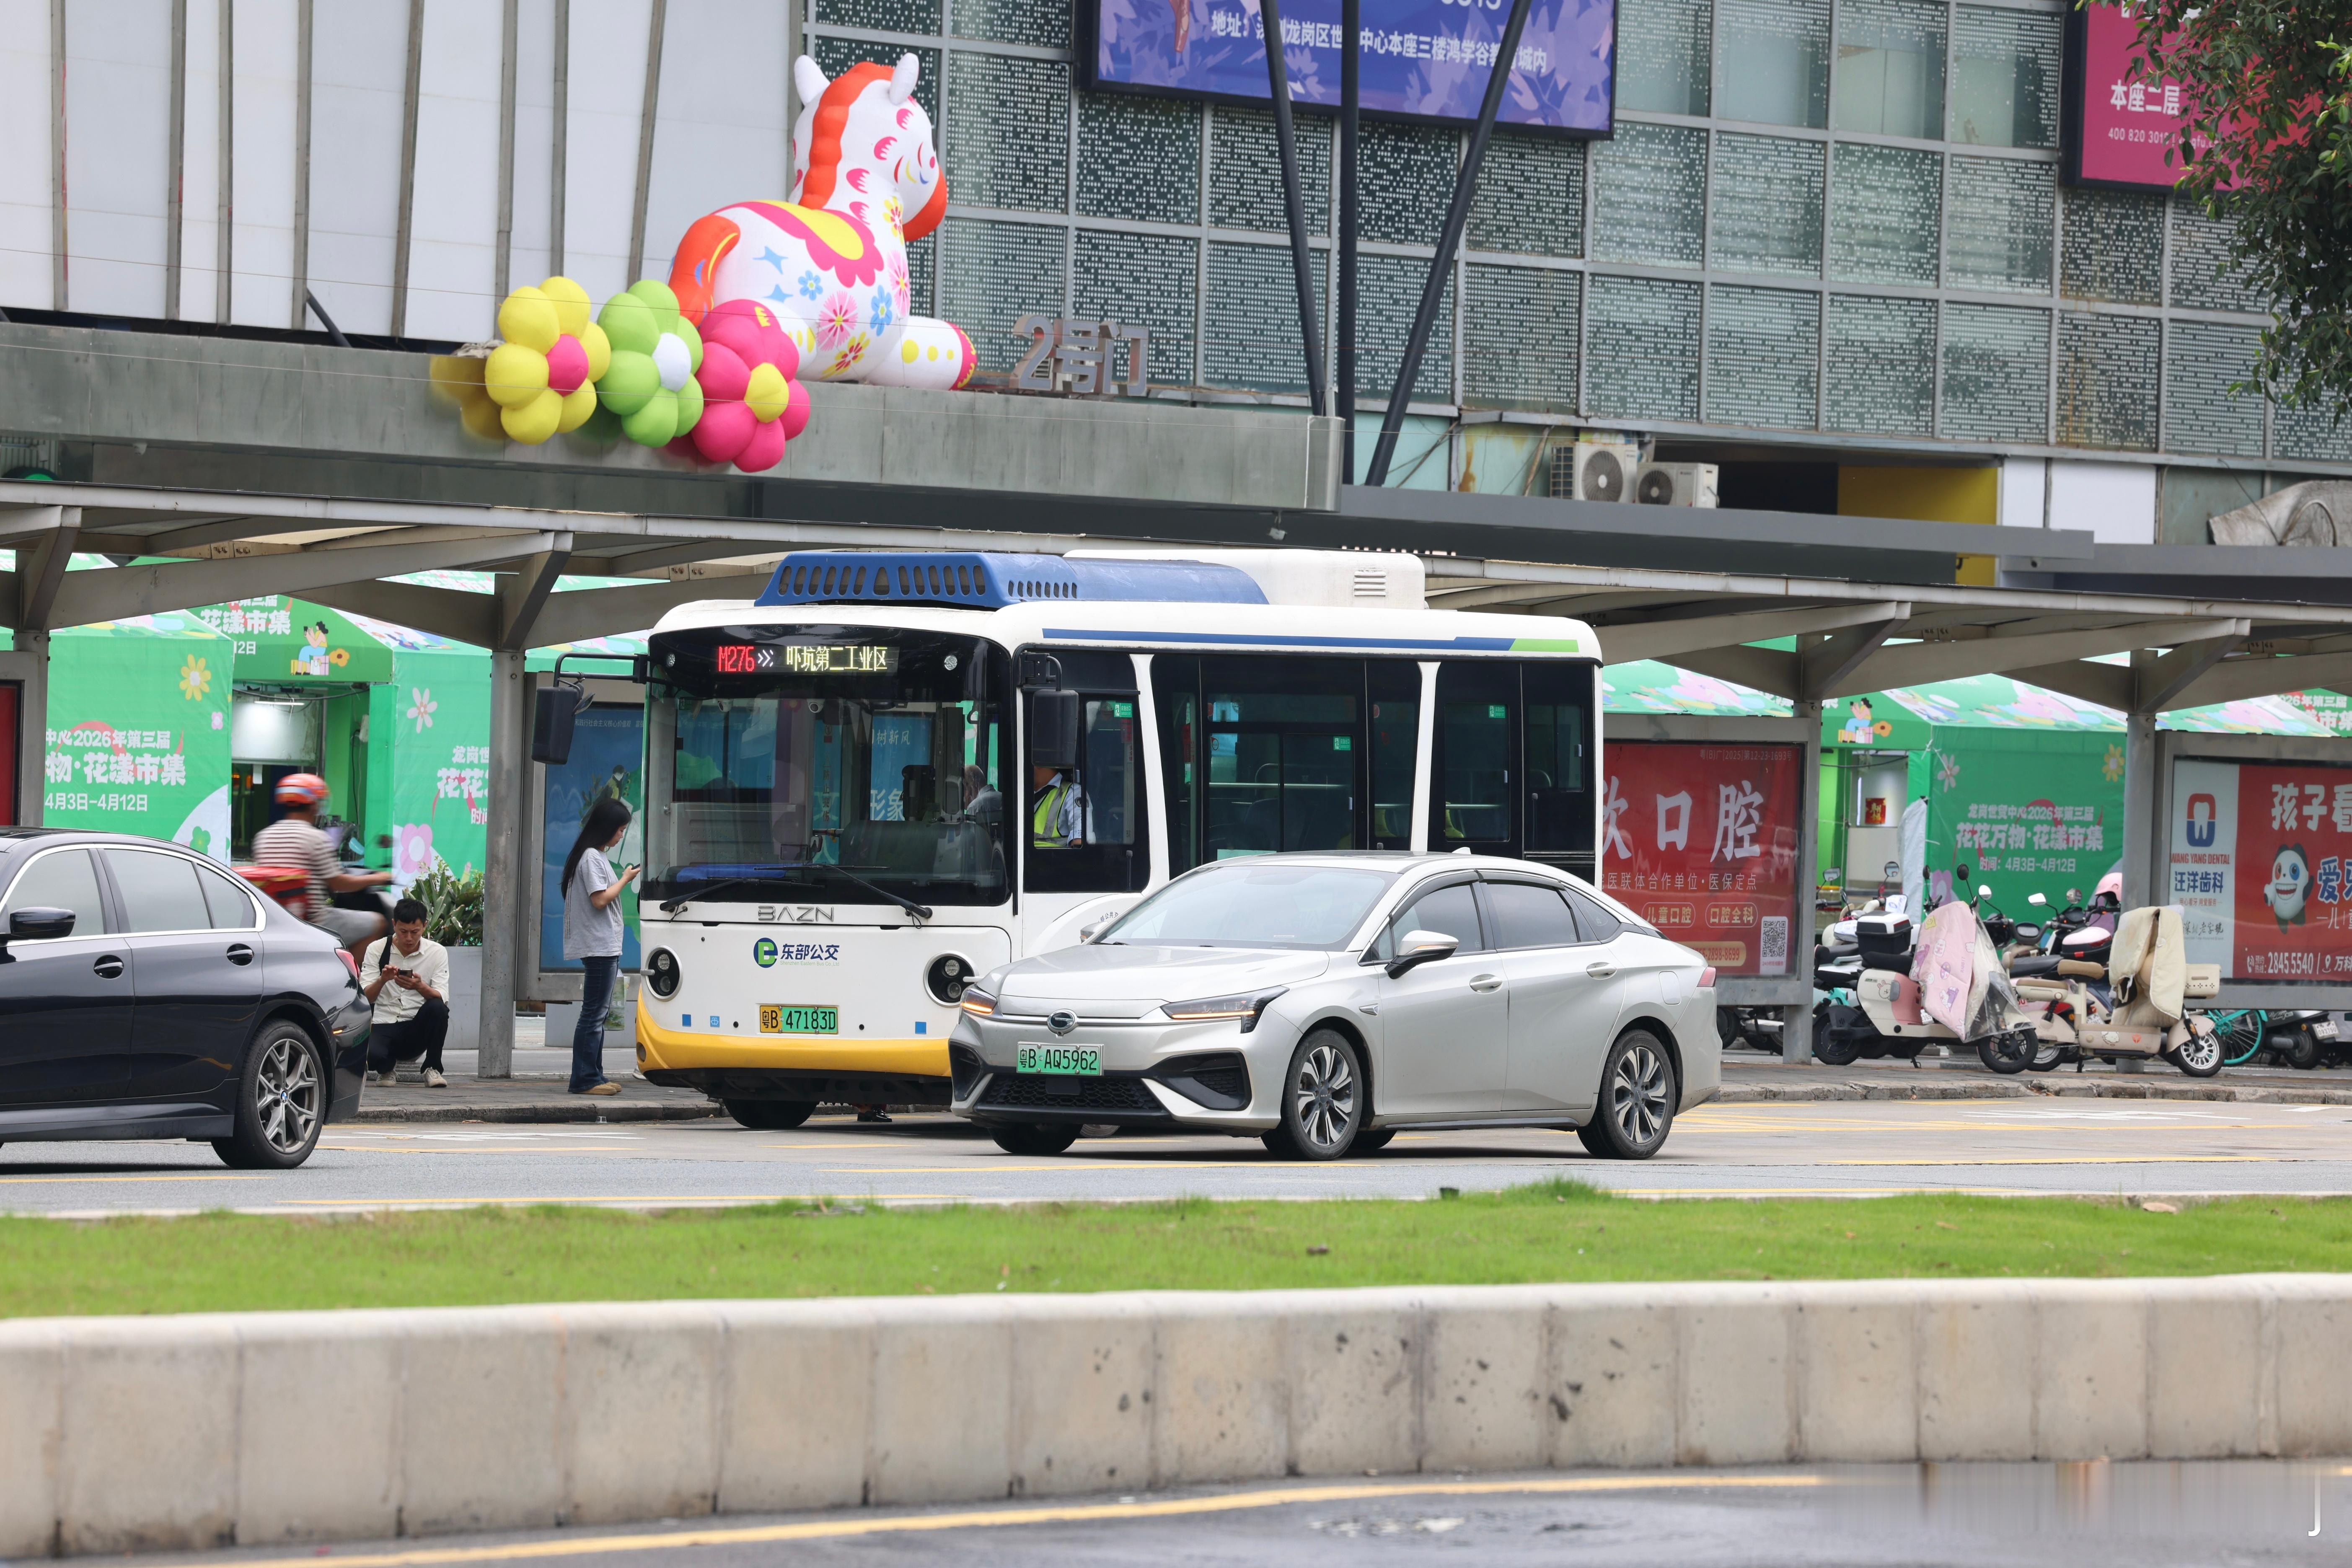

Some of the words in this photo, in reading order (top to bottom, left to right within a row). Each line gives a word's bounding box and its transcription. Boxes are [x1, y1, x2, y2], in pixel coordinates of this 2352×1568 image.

[2110, 79, 2179, 116] 本座二层
[2108, 127, 2125, 140] 400
[2128, 129, 2145, 142] 820
[1009, 314, 1149, 396] 2号门
[718, 646, 755, 672] M276
[786, 646, 887, 672] 吓坑第二工业区
[46, 728, 171, 749] 中心2026年第三届
[437, 767, 489, 799] 花花
[45, 792, 148, 812] 4月3日-4月12日
[1968, 803, 2094, 821] 龙岗世贸中心2026年第三届
[2171, 853, 2189, 863] WANG
[2190, 853, 2206, 864] YANG
[2208, 854, 2230, 864] DENTAL
[2174, 871, 2223, 893] 汪洋齿科
[1646, 906, 1691, 924] 儿童口腔
[1710, 906, 1754, 924] 口腔全科
[780, 943, 840, 961] 东部公交
[2267, 952, 2289, 974] 2845
[2291, 952, 2313, 974] 5540
